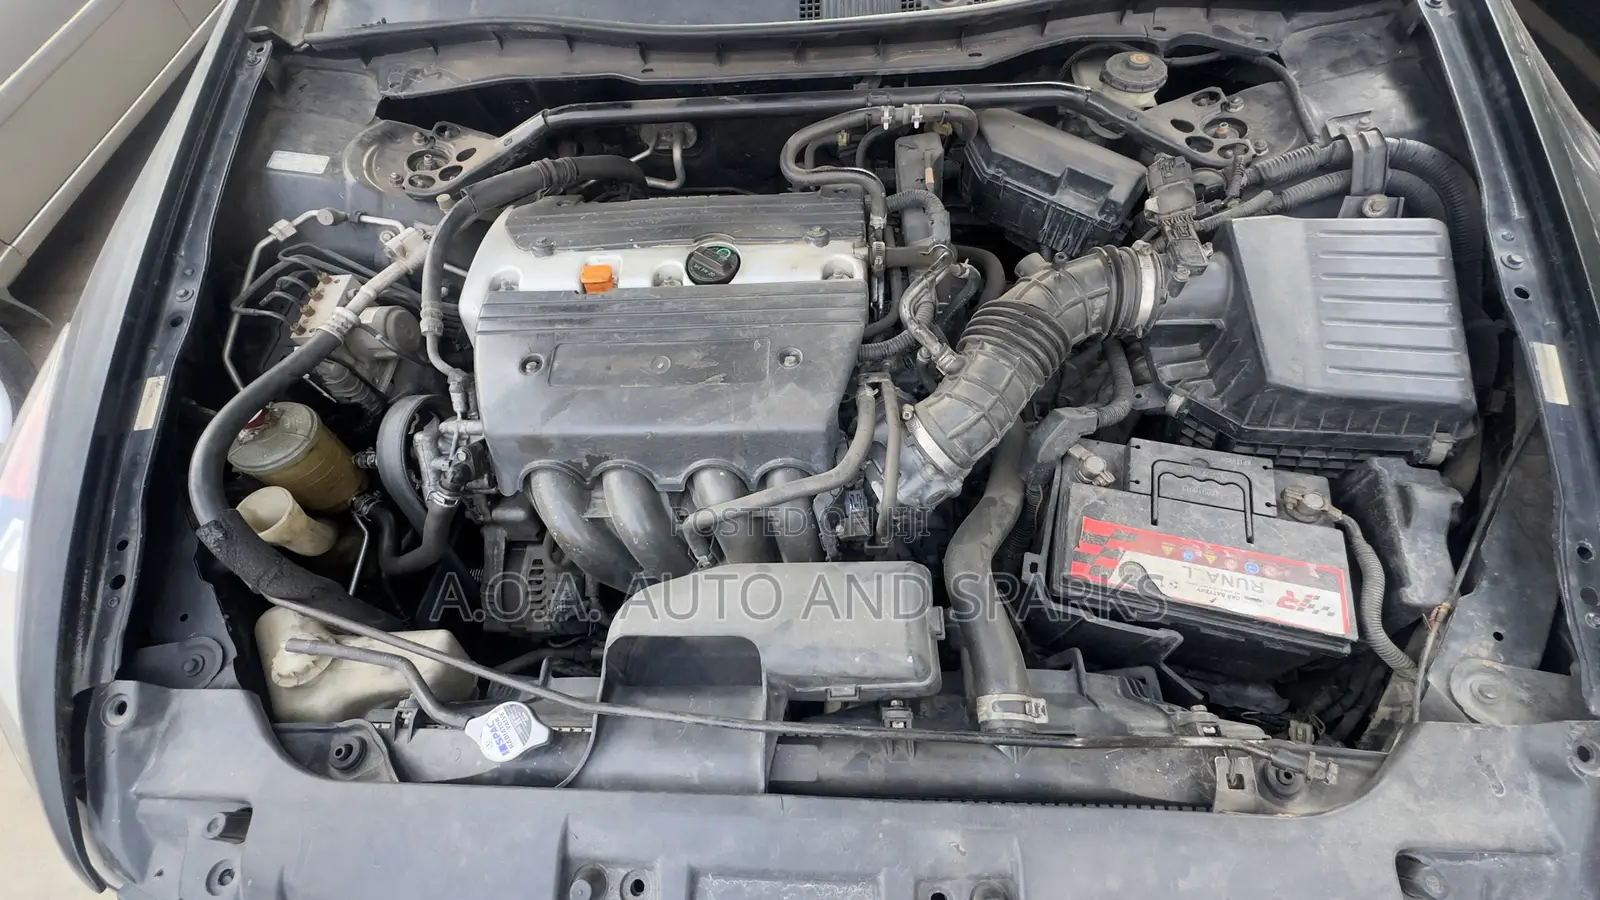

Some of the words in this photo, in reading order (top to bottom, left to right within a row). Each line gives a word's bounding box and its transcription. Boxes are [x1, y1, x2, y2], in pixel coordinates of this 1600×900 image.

[1196, 587, 1227, 600] BATTERY
[1227, 593, 1241, 601] CAR
[499, 712, 511, 731] VALVE
[495, 716, 515, 749] RADIATOR
